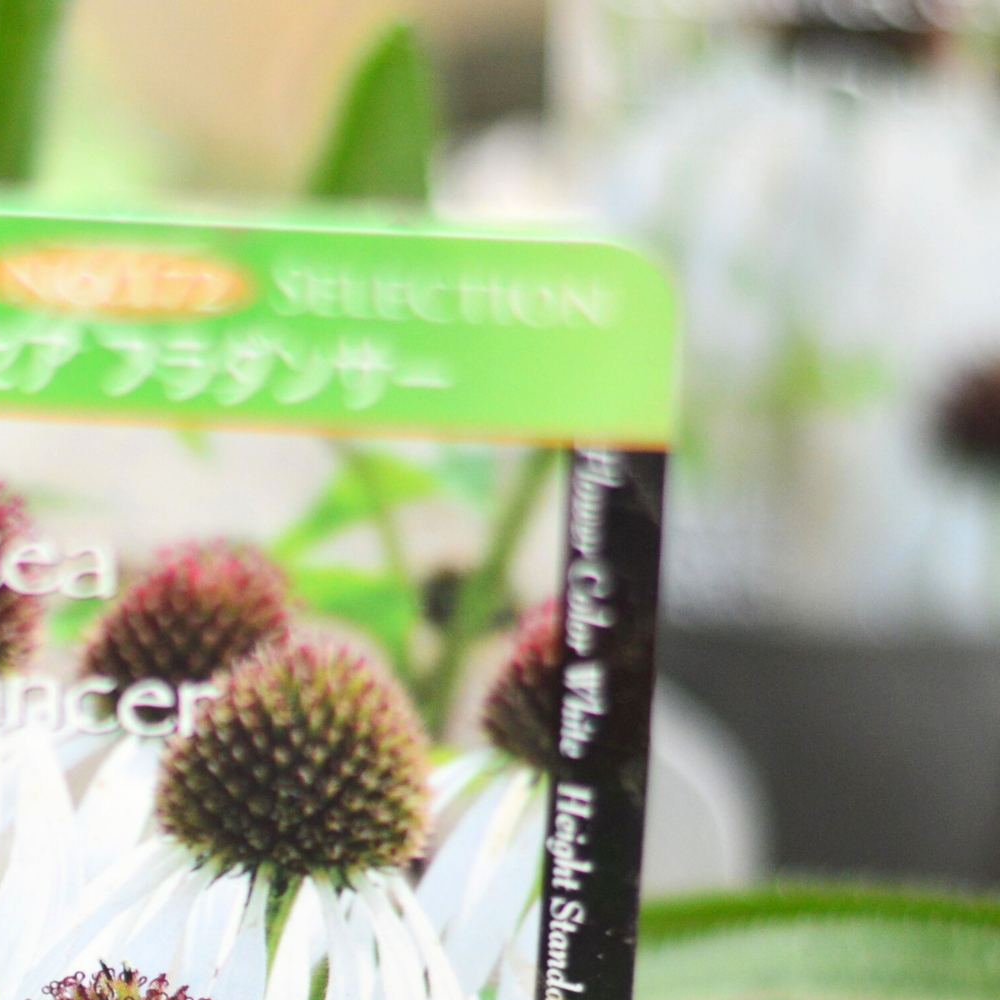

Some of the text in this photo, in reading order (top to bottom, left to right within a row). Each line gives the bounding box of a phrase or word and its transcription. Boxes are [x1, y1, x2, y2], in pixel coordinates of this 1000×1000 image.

[270, 259, 614, 328] SELECTION
[565, 559, 614, 657] Color
[545, 783, 594, 891] Height
